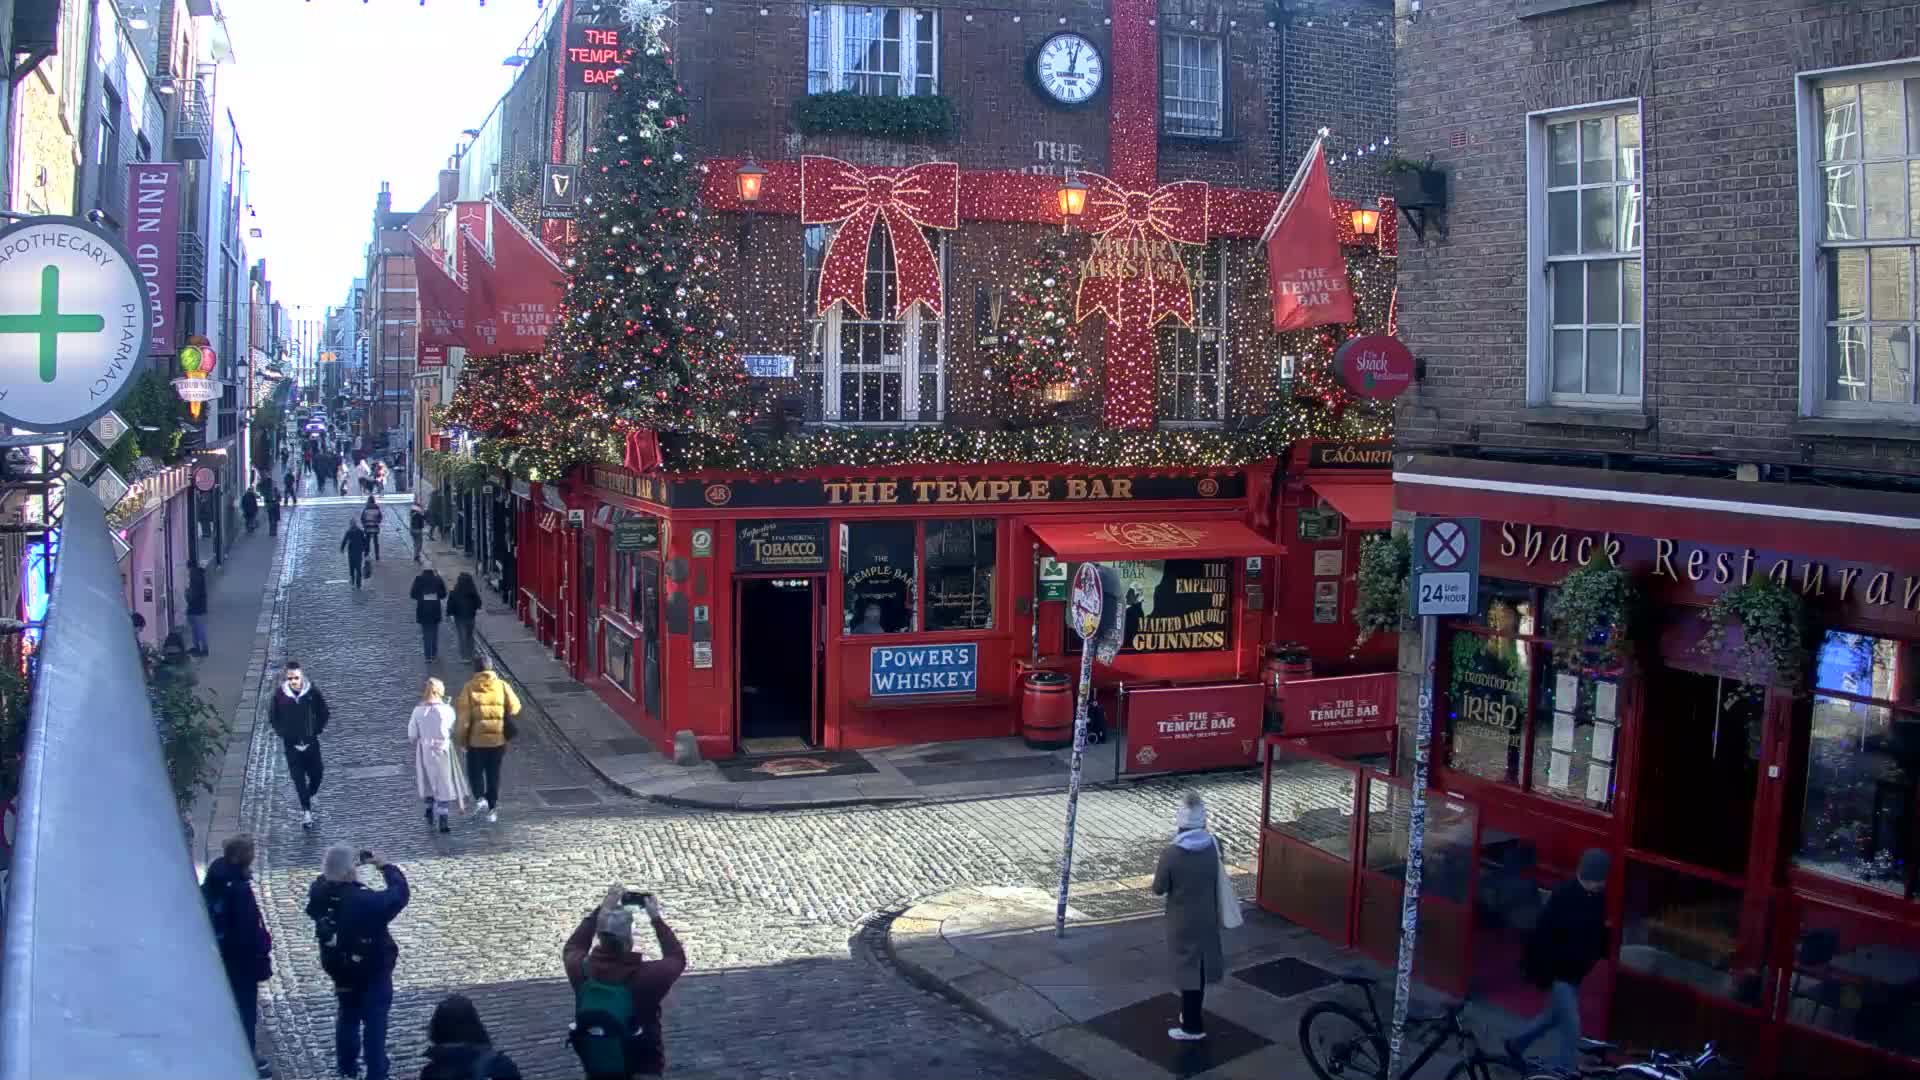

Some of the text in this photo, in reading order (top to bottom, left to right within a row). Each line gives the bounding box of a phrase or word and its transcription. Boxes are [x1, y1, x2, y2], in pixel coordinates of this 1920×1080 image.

[584, 29, 617, 45] THE
[1033, 141, 1082, 162] THE
[136, 172, 169, 233] NINE
[1301, 268, 1328, 279] THE
[1280, 279, 1343, 295] TEMPLE
[1297, 293, 1330, 305] BAR
[519, 303, 544, 312] THE
[516, 325, 549, 336] BAR
[90, 303, 136, 400] PHARMACY
[1356, 350, 1388, 373] Shack
[636, 477, 653, 499] BAR
[823, 479, 1133, 504] THE TEMPLE BAR
[751, 539, 816, 561] TOBACCO
[1500, 520, 1621, 568] Shack
[847, 566, 915, 589] TEMPLE BAR
[1122, 568, 1145, 578] BAR
[1204, 563, 1226, 578] THE
[1176, 578, 1226, 593] EMPEROR
[1422, 584, 1443, 603] 24
[1212, 593, 1226, 607] OF
[1444, 594, 1466, 602] HOUR
[1138, 609, 1226, 633] MALTED LIQUORS
[1133, 631, 1225, 651] GUINNESS
[880, 648, 969, 668] POWER'S
[873, 671, 974, 691] WHISKEY
[1336, 700, 1354, 709] THE
[1187, 711, 1208, 721] THE
[1309, 705, 1379, 721] TEMPLE BAR
[1157, 717, 1236, 733] TEMPLE BAR
